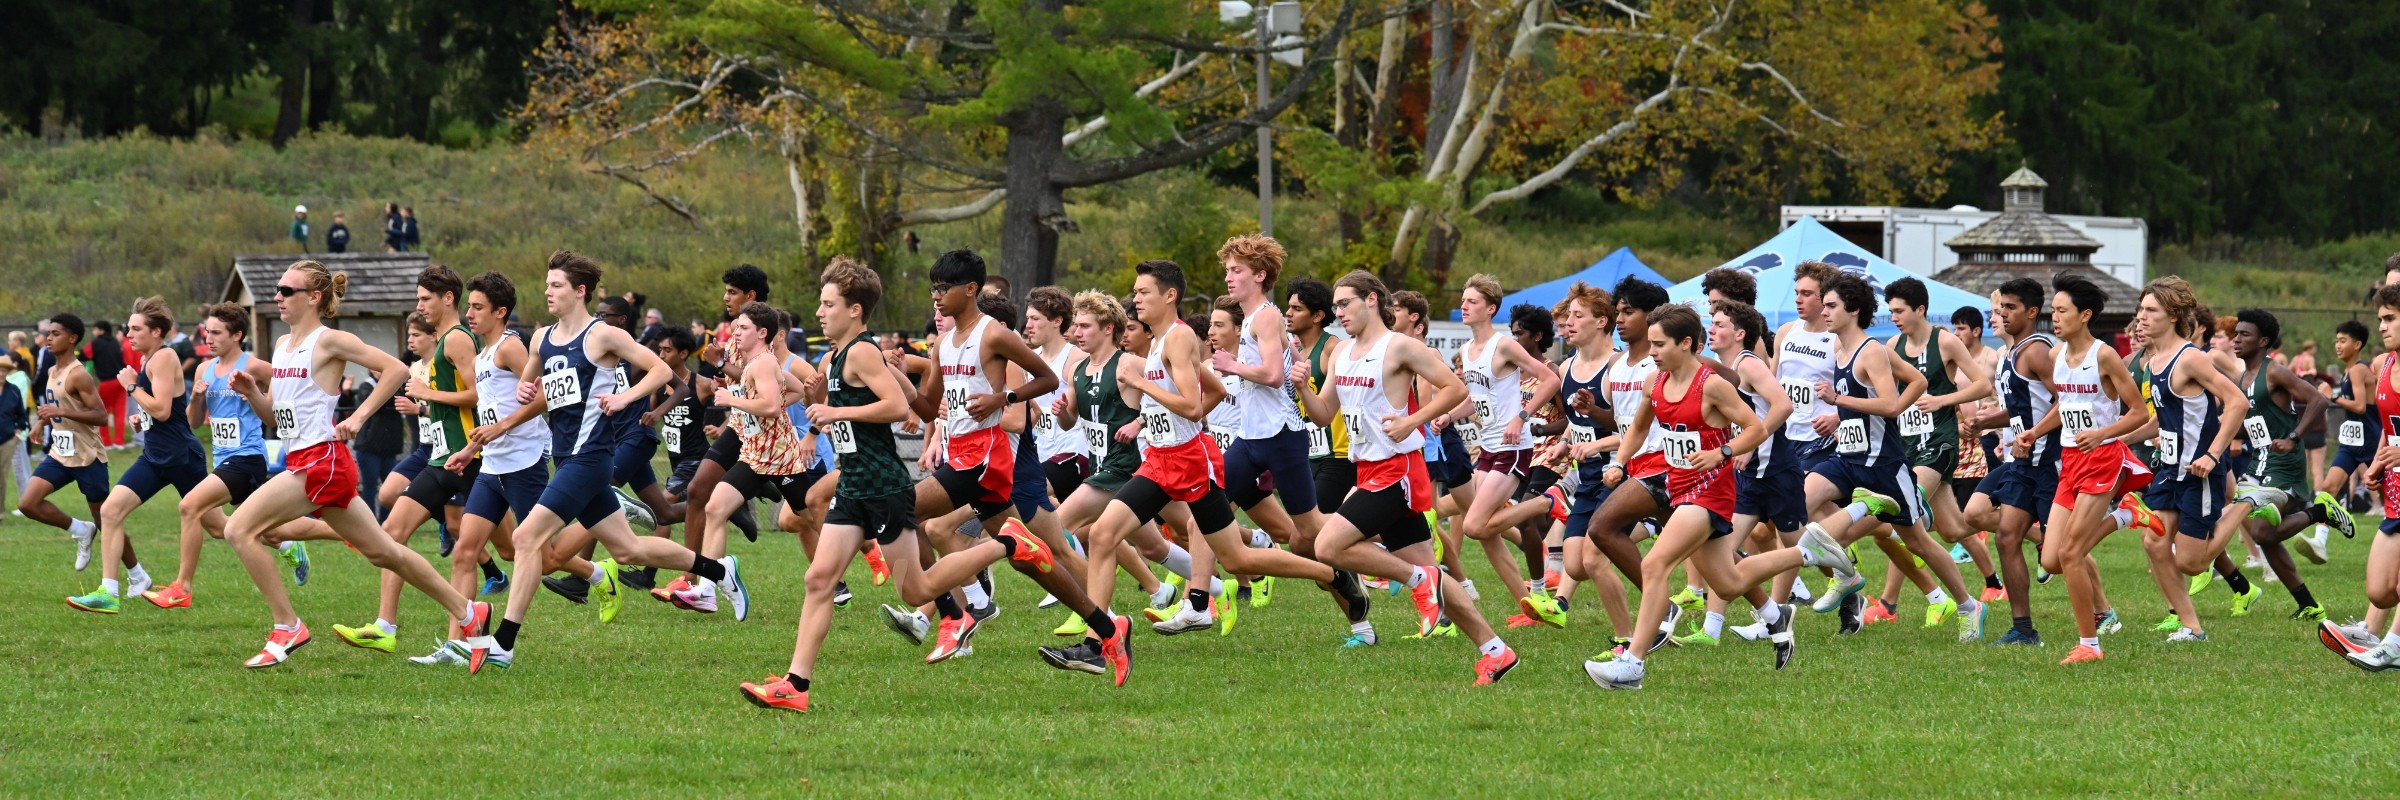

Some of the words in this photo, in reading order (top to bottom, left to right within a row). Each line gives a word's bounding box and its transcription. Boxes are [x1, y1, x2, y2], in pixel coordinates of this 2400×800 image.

[1785, 342, 1827, 359] Chatham
[545, 375, 575, 401] 2252
[2077, 384, 2098, 393] HILLS
[1902, 410, 1929, 428] 1485
[2062, 410, 2092, 429] 1876
[1839, 425, 1863, 445] 2260
[2341, 424, 2361, 439] 2298
[1663, 437, 1696, 459] 1718
